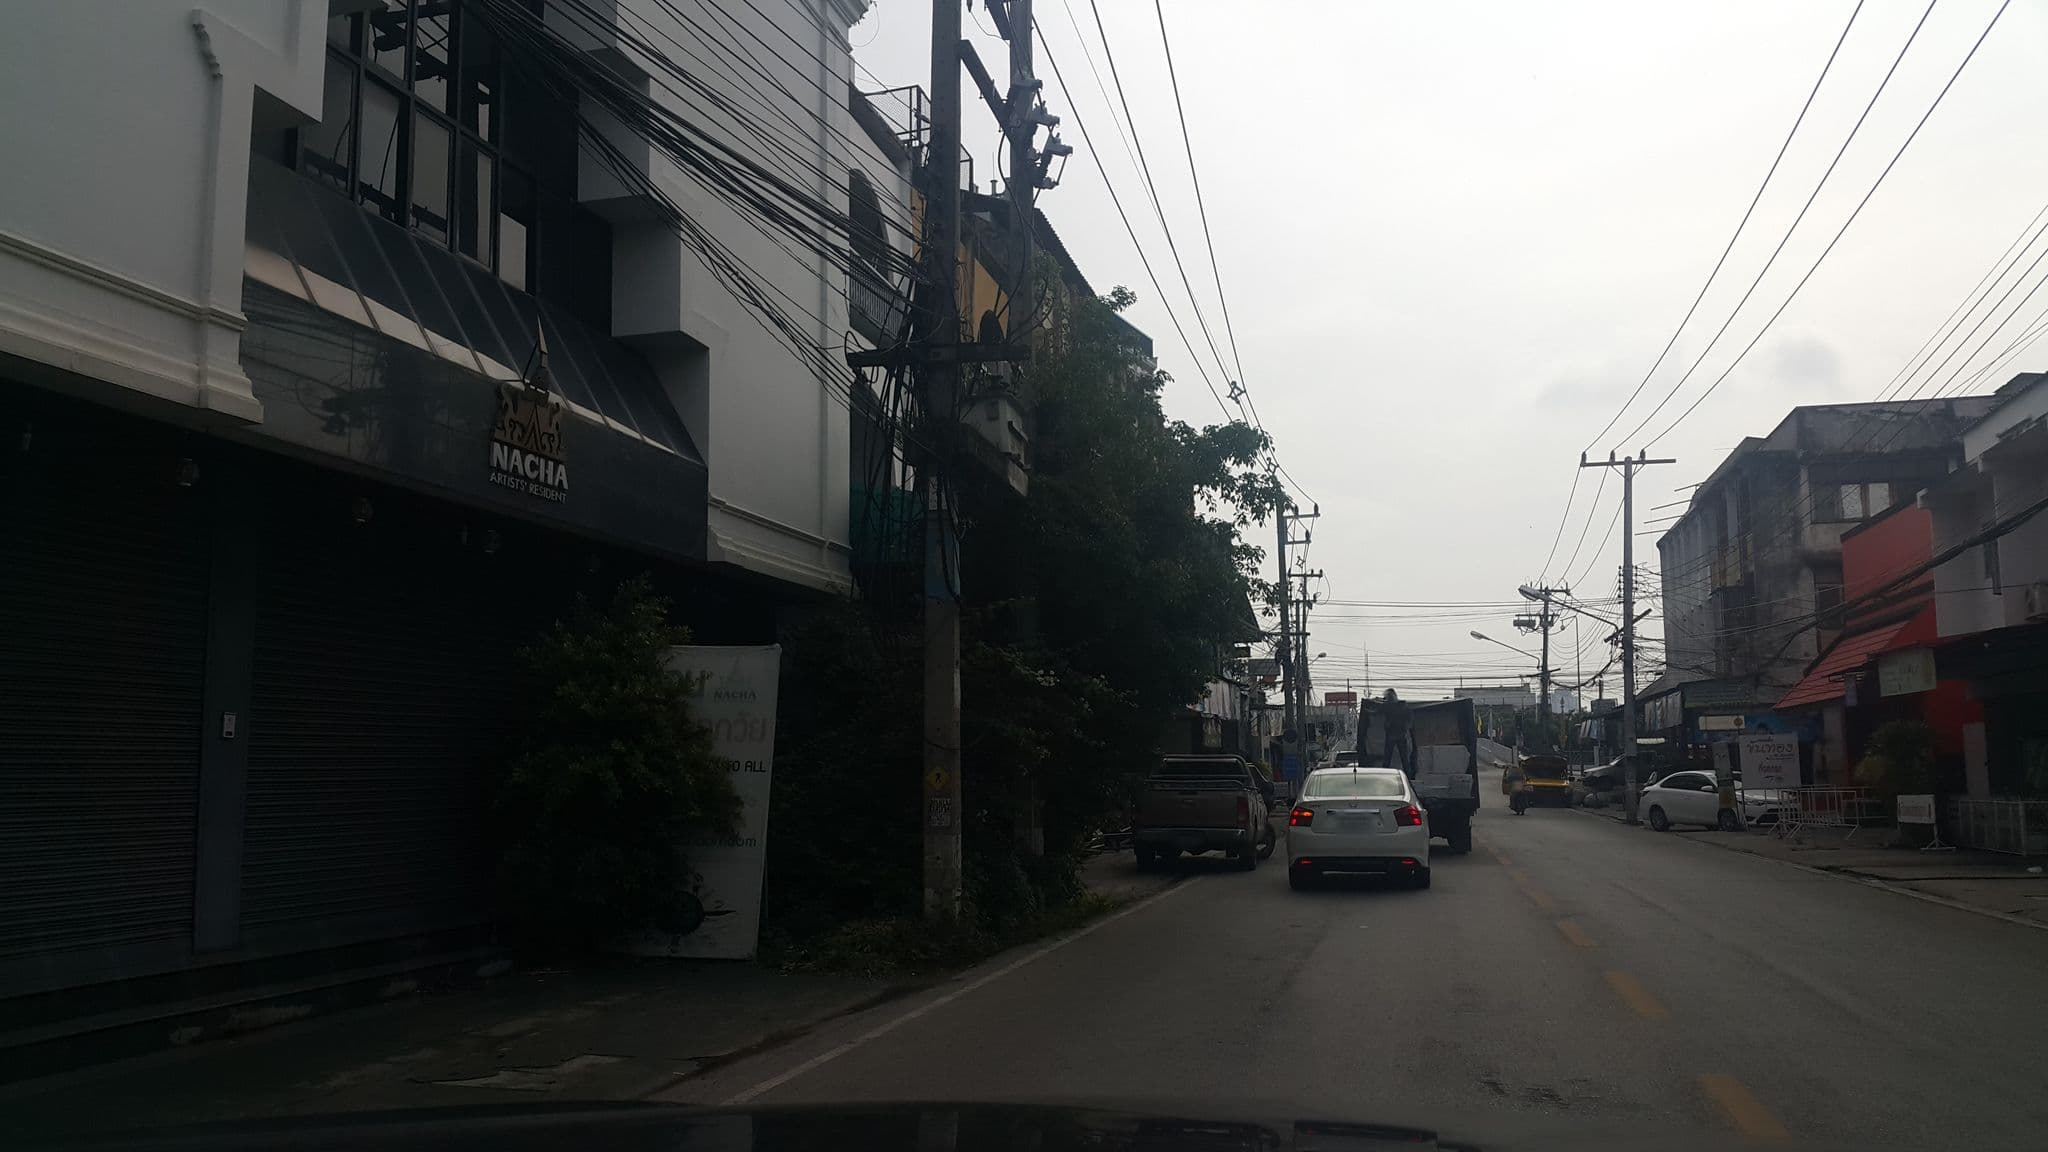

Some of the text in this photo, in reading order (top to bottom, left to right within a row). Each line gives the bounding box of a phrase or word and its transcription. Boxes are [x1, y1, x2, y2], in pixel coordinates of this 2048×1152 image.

[490, 441, 569, 490] NACHA
[528, 483, 567, 502] RESIDENT
[744, 760, 767, 772] ALL
